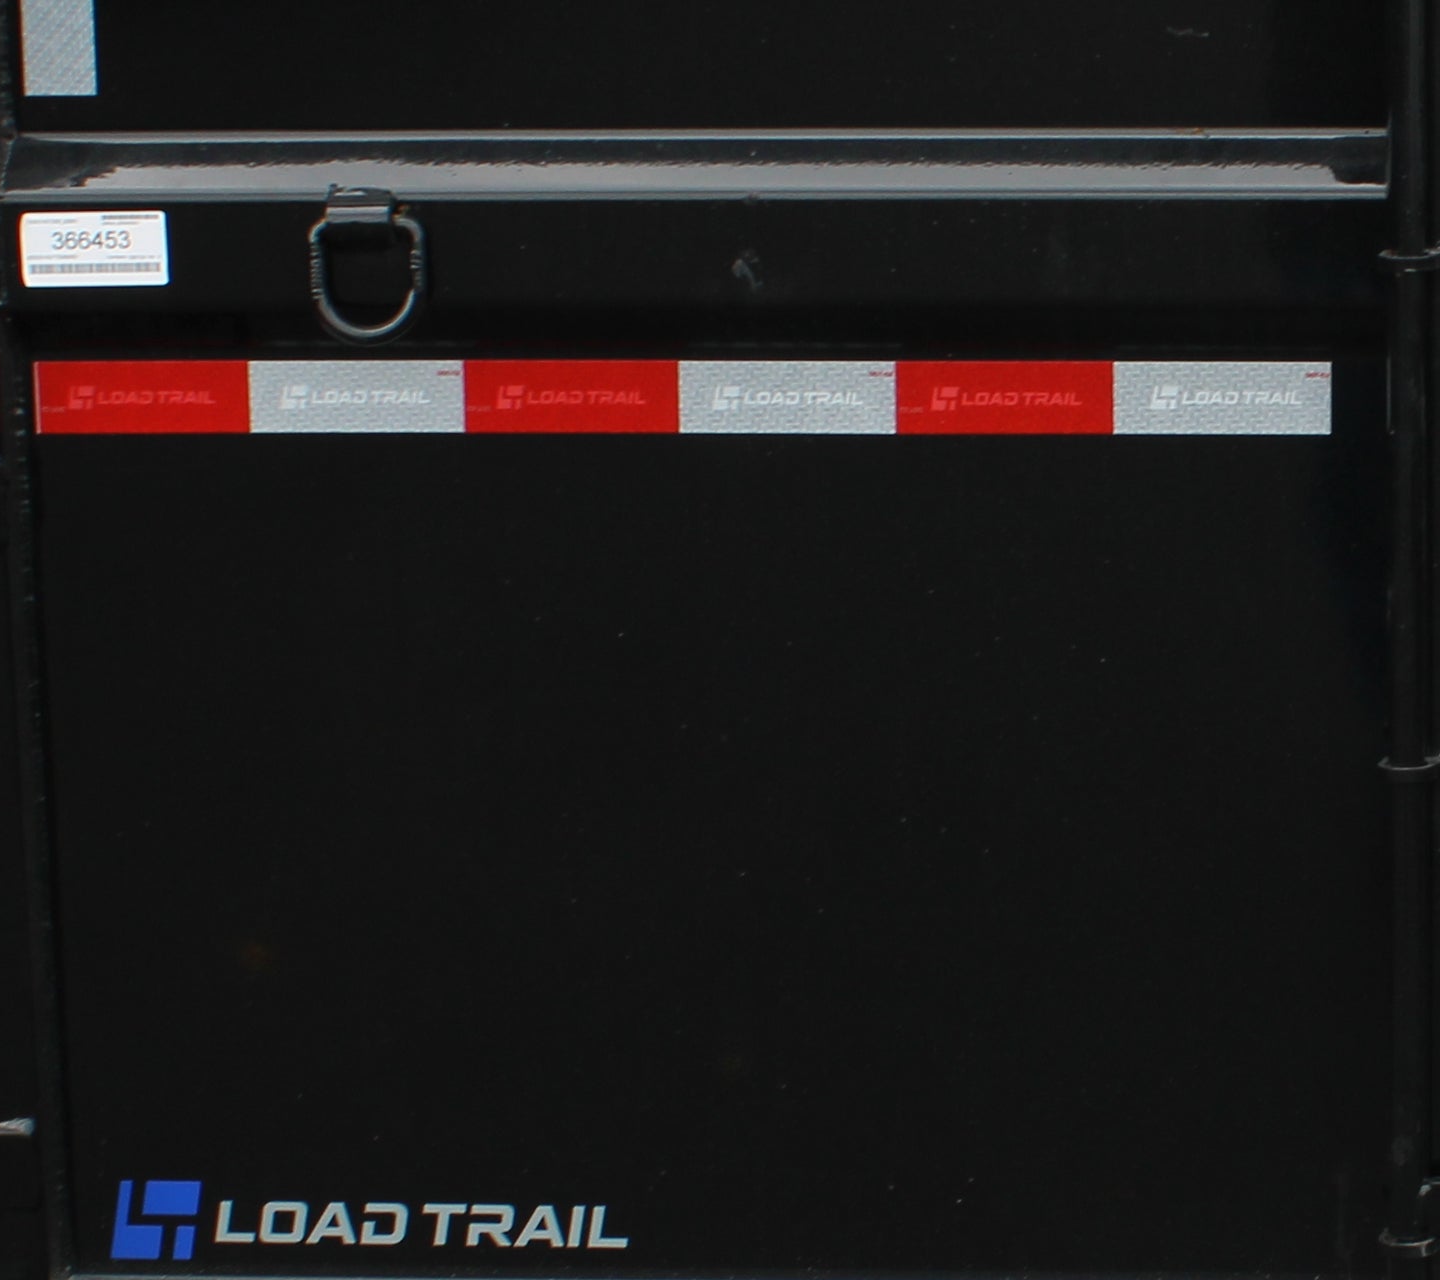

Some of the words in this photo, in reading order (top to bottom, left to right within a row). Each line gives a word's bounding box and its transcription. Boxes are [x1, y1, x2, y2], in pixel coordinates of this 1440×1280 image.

[51, 230, 132, 250] 366453
[97, 390, 153, 405] LOAD
[157, 390, 216, 405] TRAIL
[312, 390, 366, 405] LOAD
[371, 390, 431, 405] TRAIL
[526, 390, 583, 405] LOAD
[587, 390, 646, 405] TRAIL
[744, 391, 801, 406] LOAD
[803, 391, 864, 406] TRAIL
[962, 391, 1018, 407] LOAD
[1022, 391, 1082, 407] TRAIL
[1181, 392, 1238, 407] LOAD
[1241, 392, 1302, 407] TRAIL
[214, 1200, 408, 1244] LOAD
[422, 1203, 629, 1249] TRAIL
